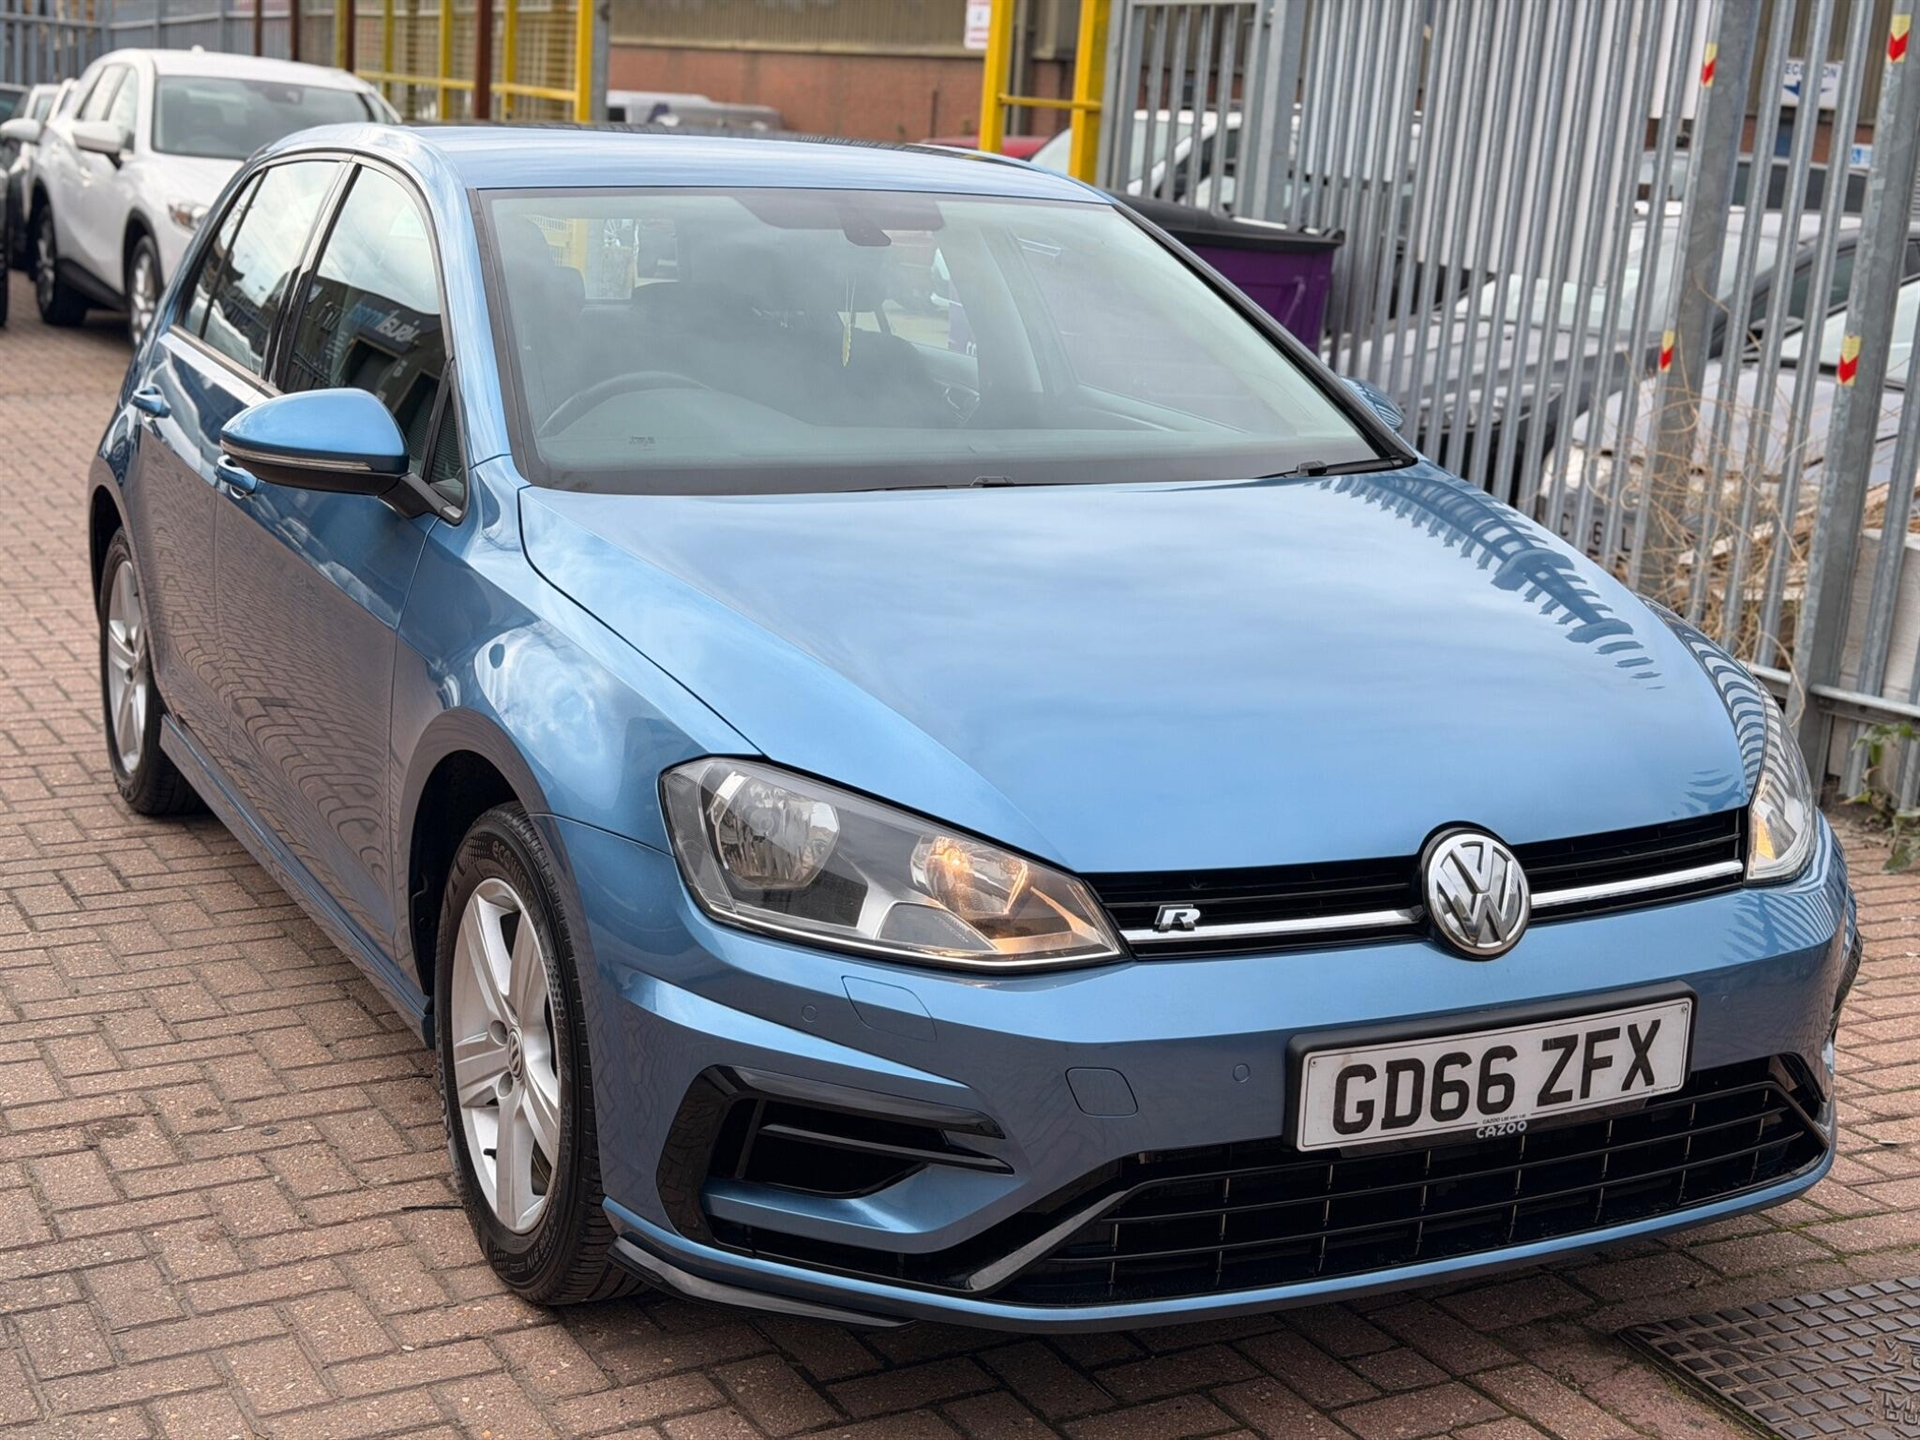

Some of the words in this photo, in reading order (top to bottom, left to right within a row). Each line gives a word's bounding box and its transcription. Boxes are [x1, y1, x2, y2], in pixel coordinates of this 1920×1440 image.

[1158, 905, 1201, 930] R
[1333, 1045, 1518, 1135] GD66
[1537, 1019, 1661, 1107] ZFX
[1476, 1120, 1528, 1139] CAZOO
